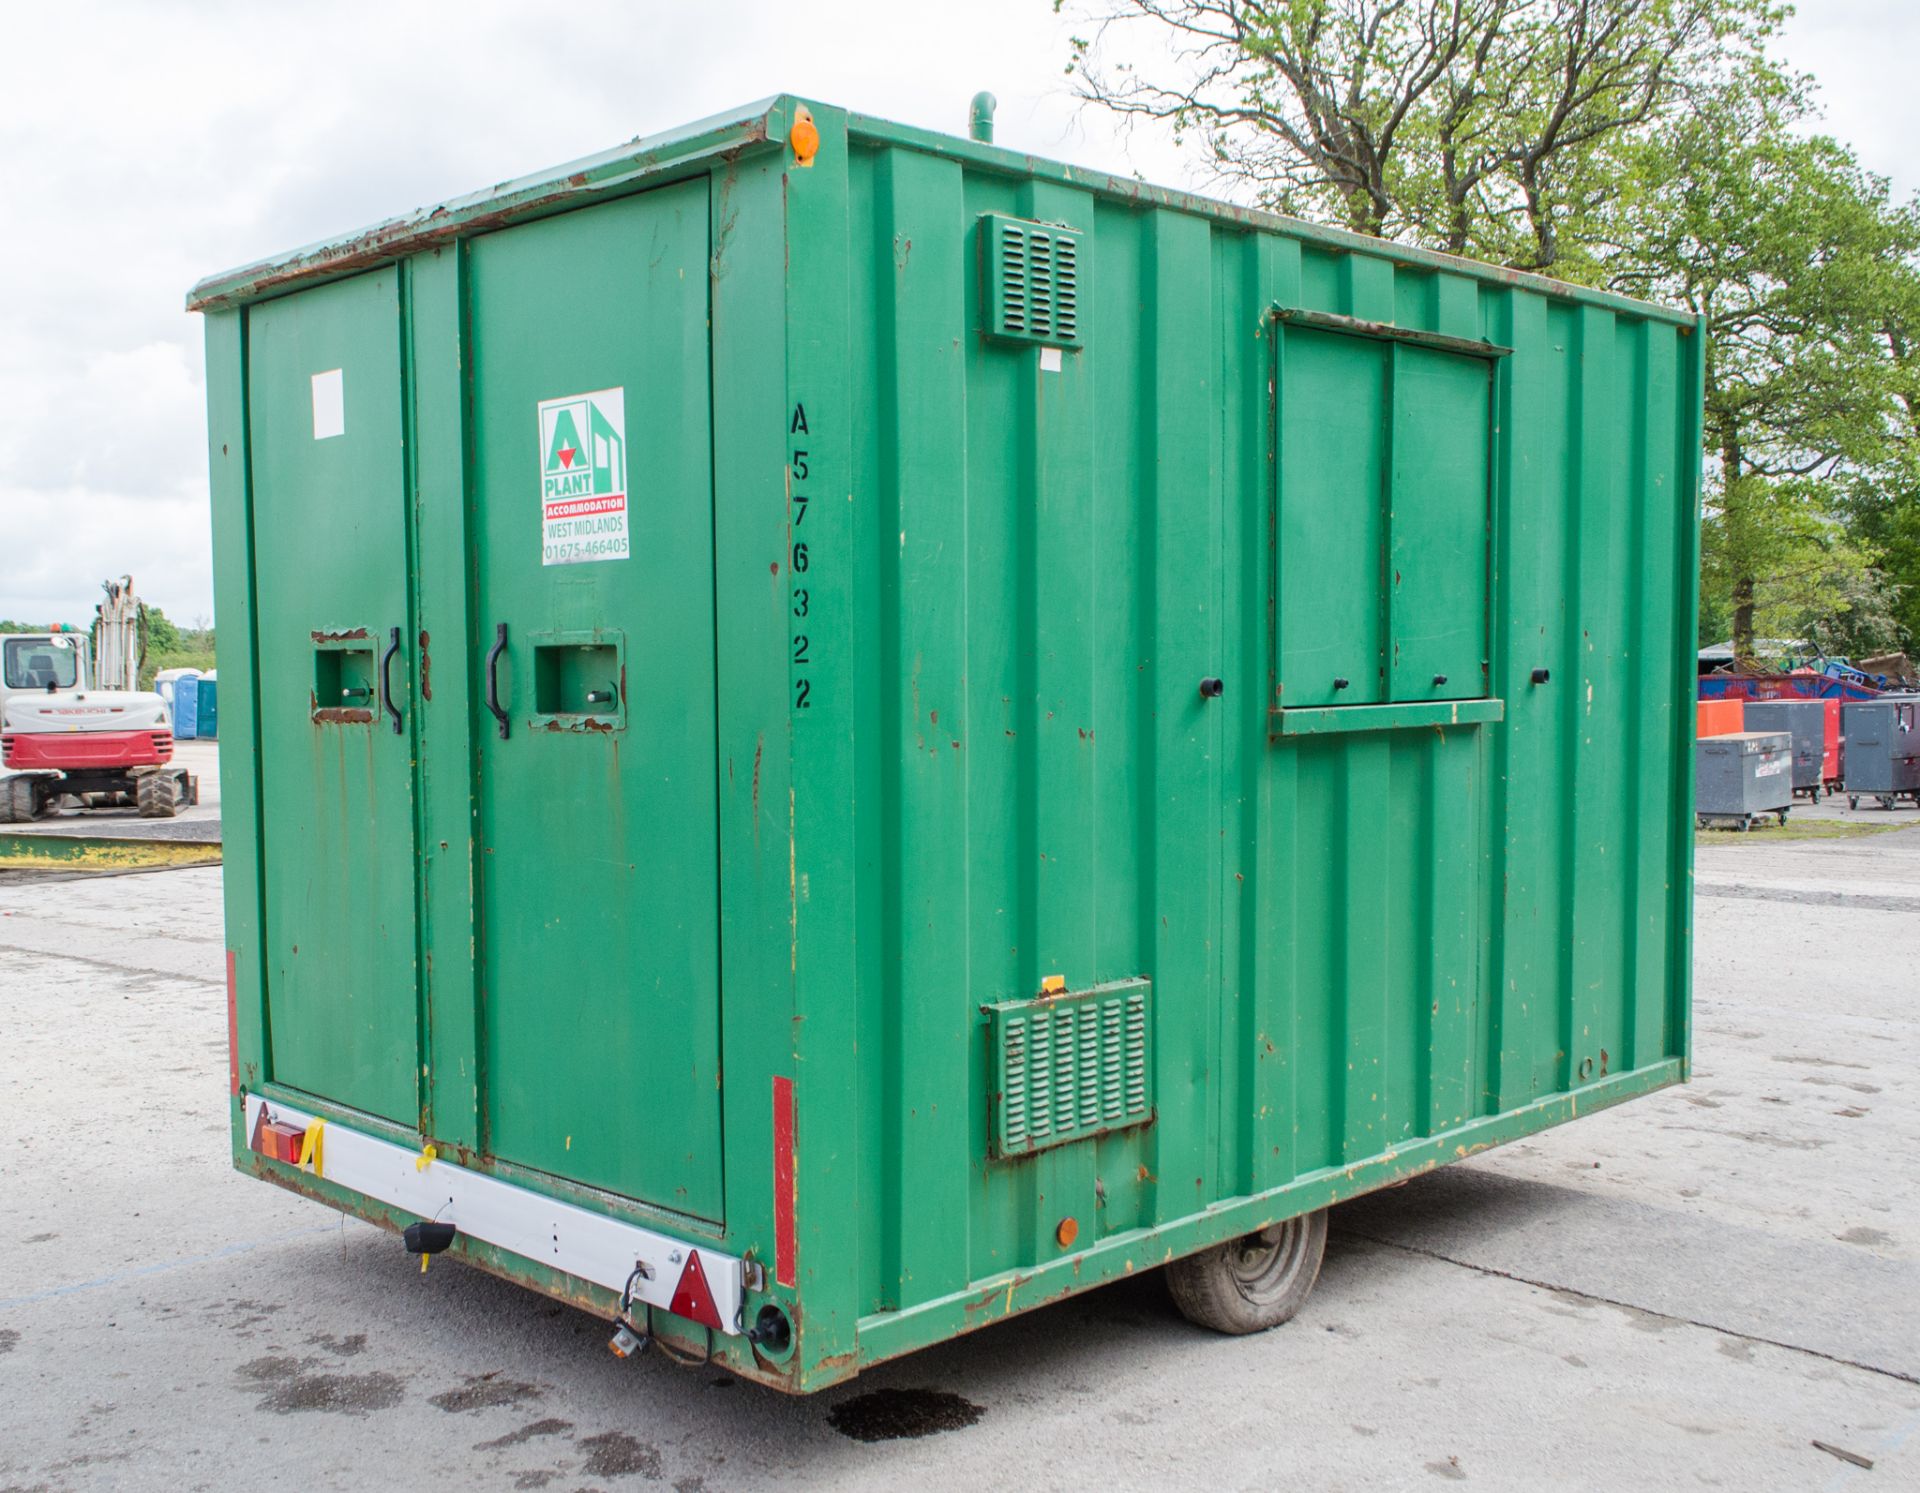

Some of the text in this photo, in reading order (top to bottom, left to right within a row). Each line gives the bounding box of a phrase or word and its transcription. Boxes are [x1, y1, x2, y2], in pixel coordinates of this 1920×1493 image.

[545, 474, 591, 498] PLANT
[547, 498, 623, 516] ACCOMMODATION
[548, 516, 623, 539] WEST MIDLANDS
[545, 538, 628, 560] 01675-466405
